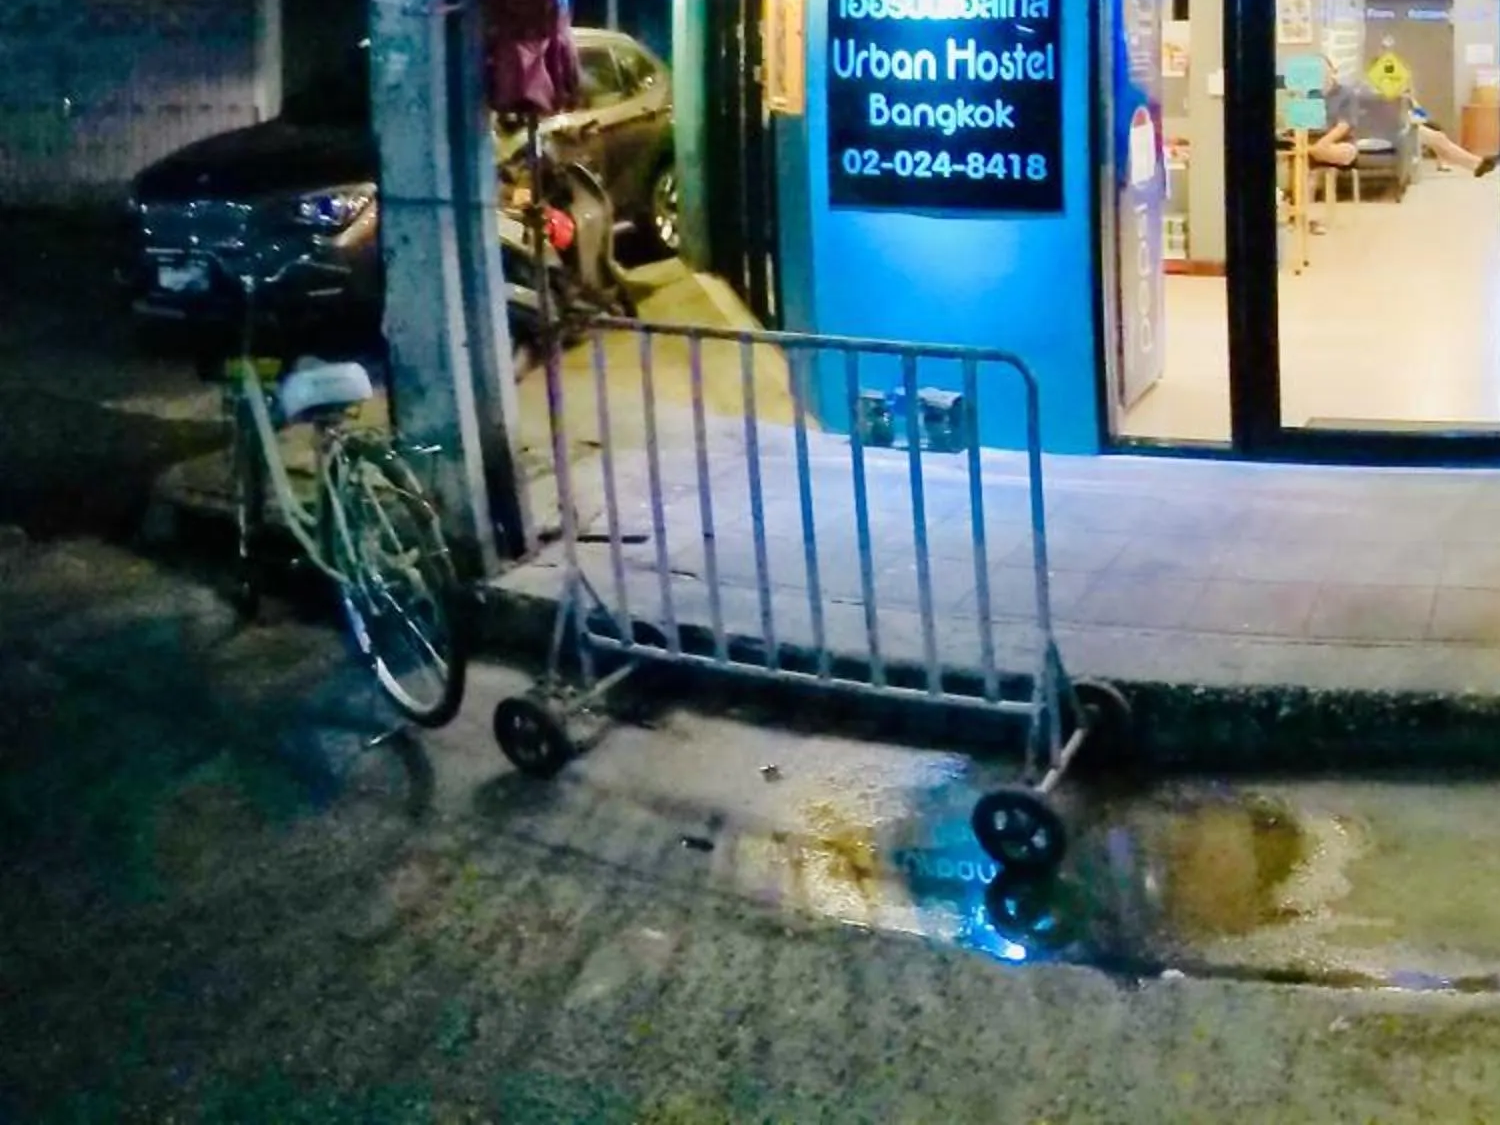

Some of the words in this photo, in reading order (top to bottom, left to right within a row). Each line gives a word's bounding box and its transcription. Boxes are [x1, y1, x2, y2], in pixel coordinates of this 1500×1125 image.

[832, 38, 937, 81] Urban
[946, 37, 1055, 81] Hostel
[869, 92, 1015, 136] Bangkok
[842, 148, 1047, 180] 02-024-8418
